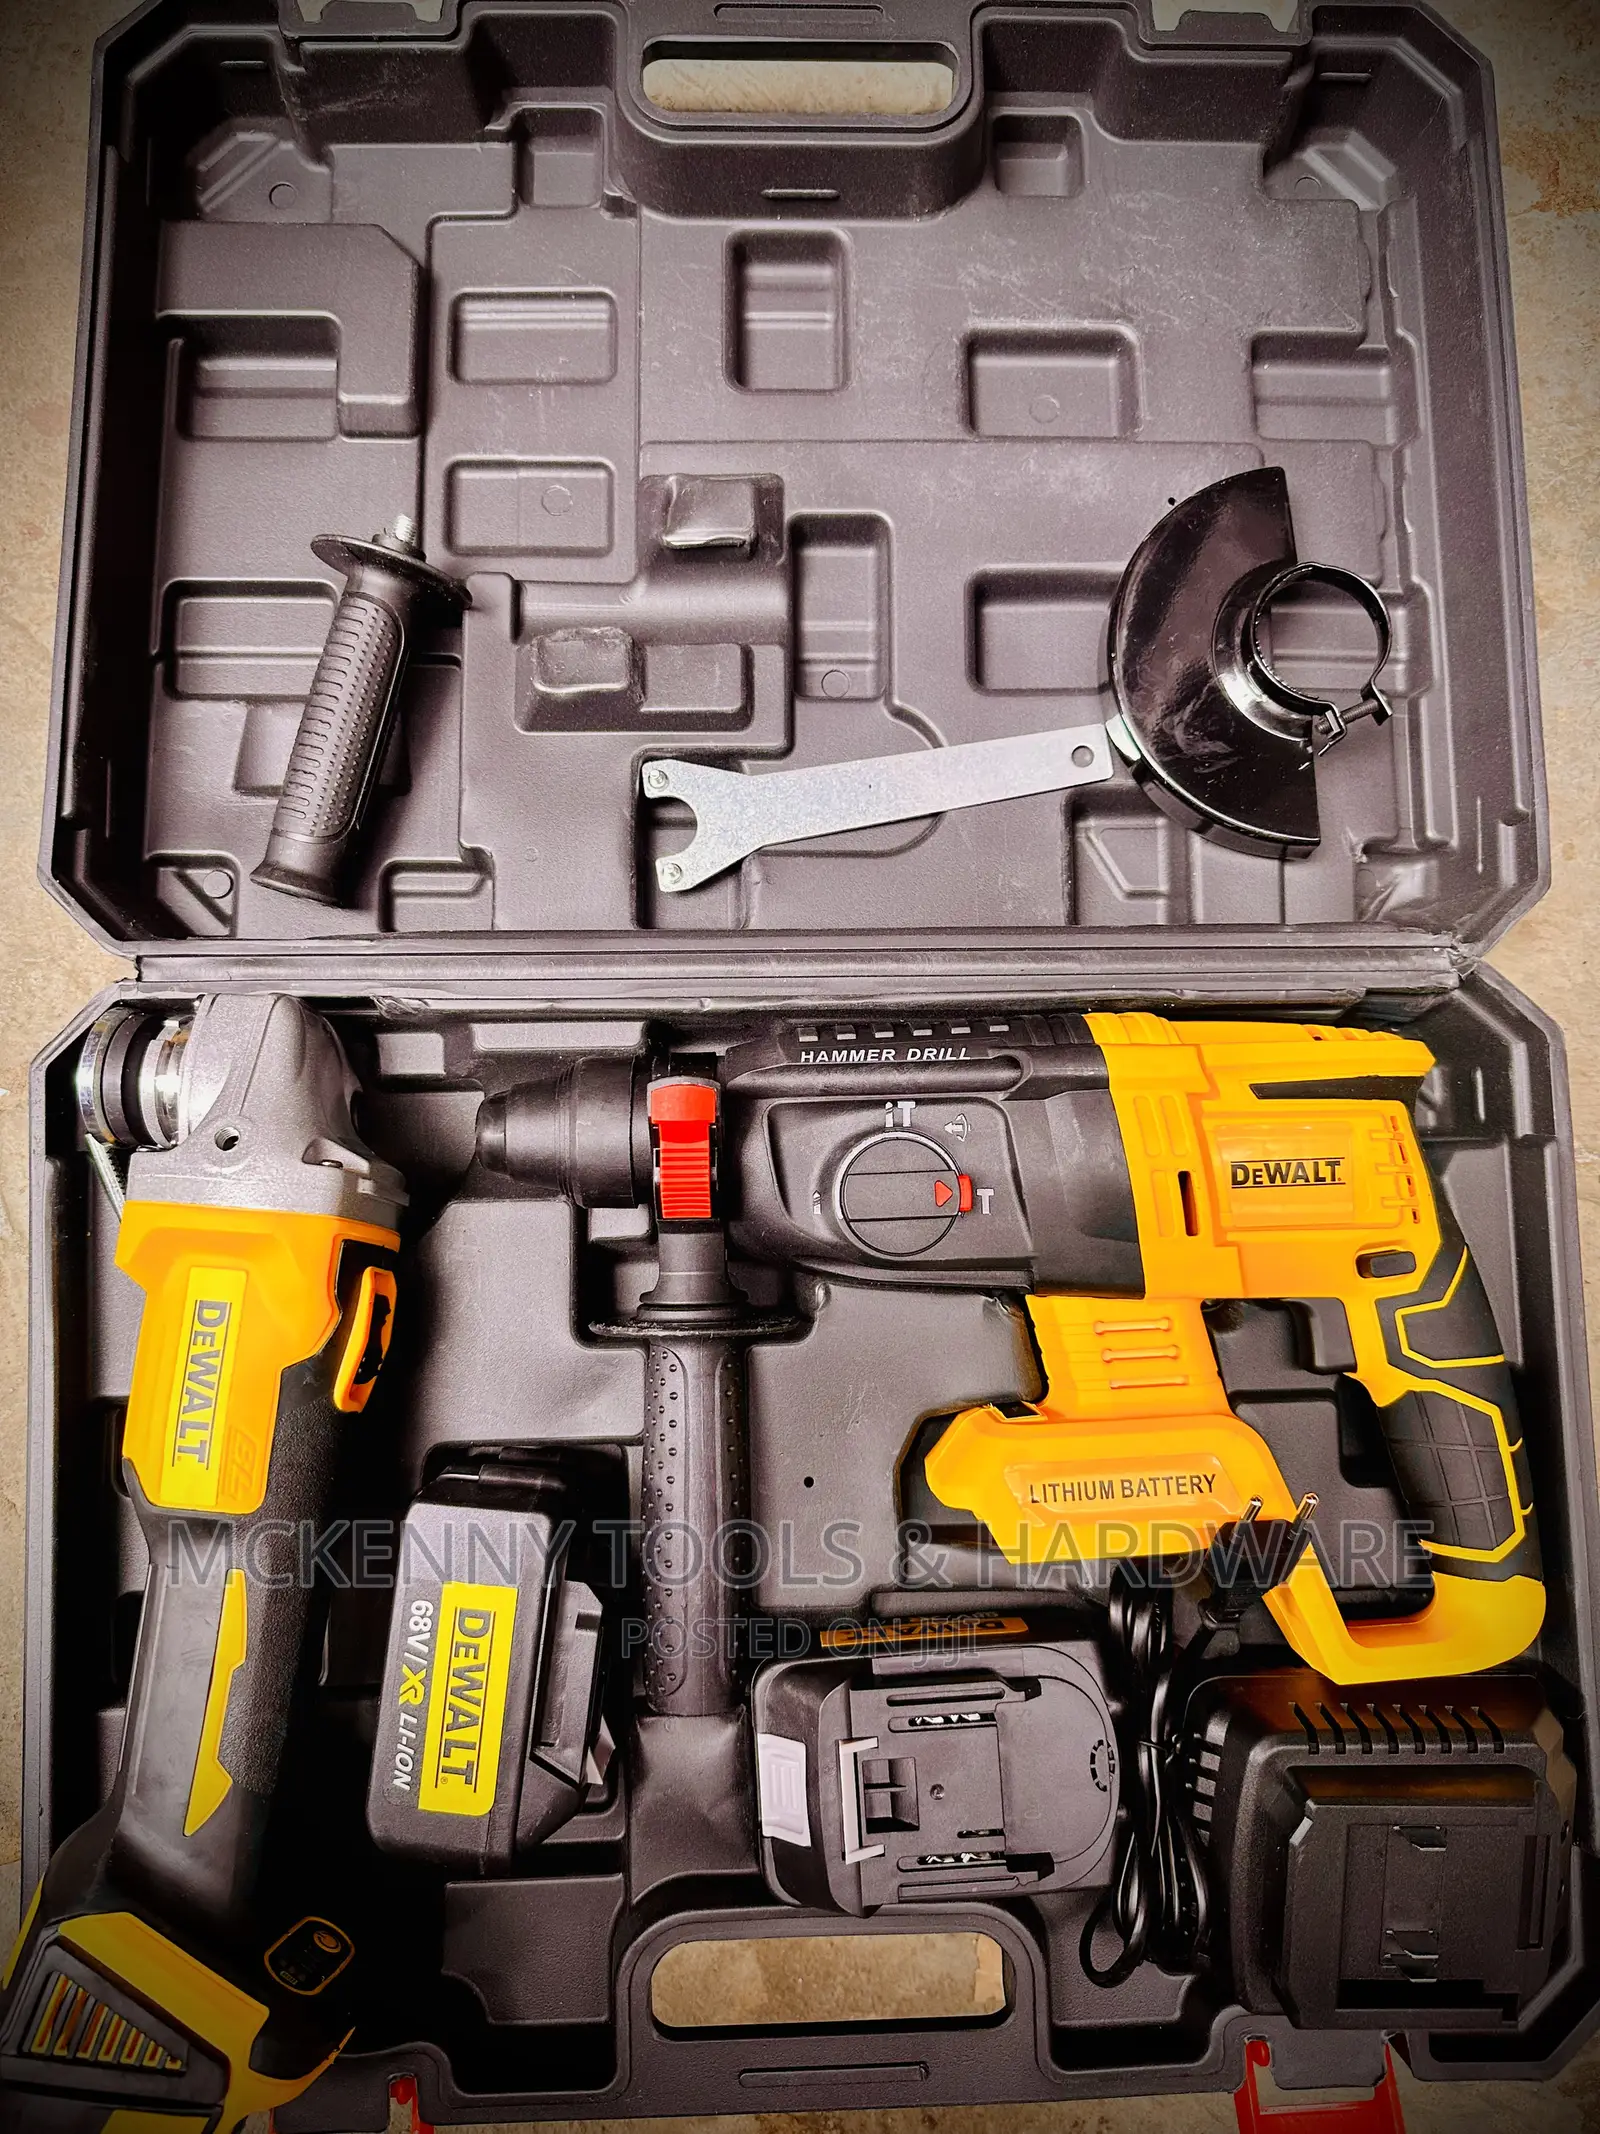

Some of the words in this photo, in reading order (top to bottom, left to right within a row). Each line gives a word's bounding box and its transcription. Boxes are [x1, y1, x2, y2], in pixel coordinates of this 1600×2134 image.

[800, 1049, 896, 1064] HAMMER
[906, 1047, 972, 1061] DRILL
[177, 1299, 229, 1464] DEWALT
[1029, 1479, 1115, 1504] LITHIUM
[1120, 1473, 1216, 1499] BATTERY
[392, 1711, 418, 1791] LI-ION
